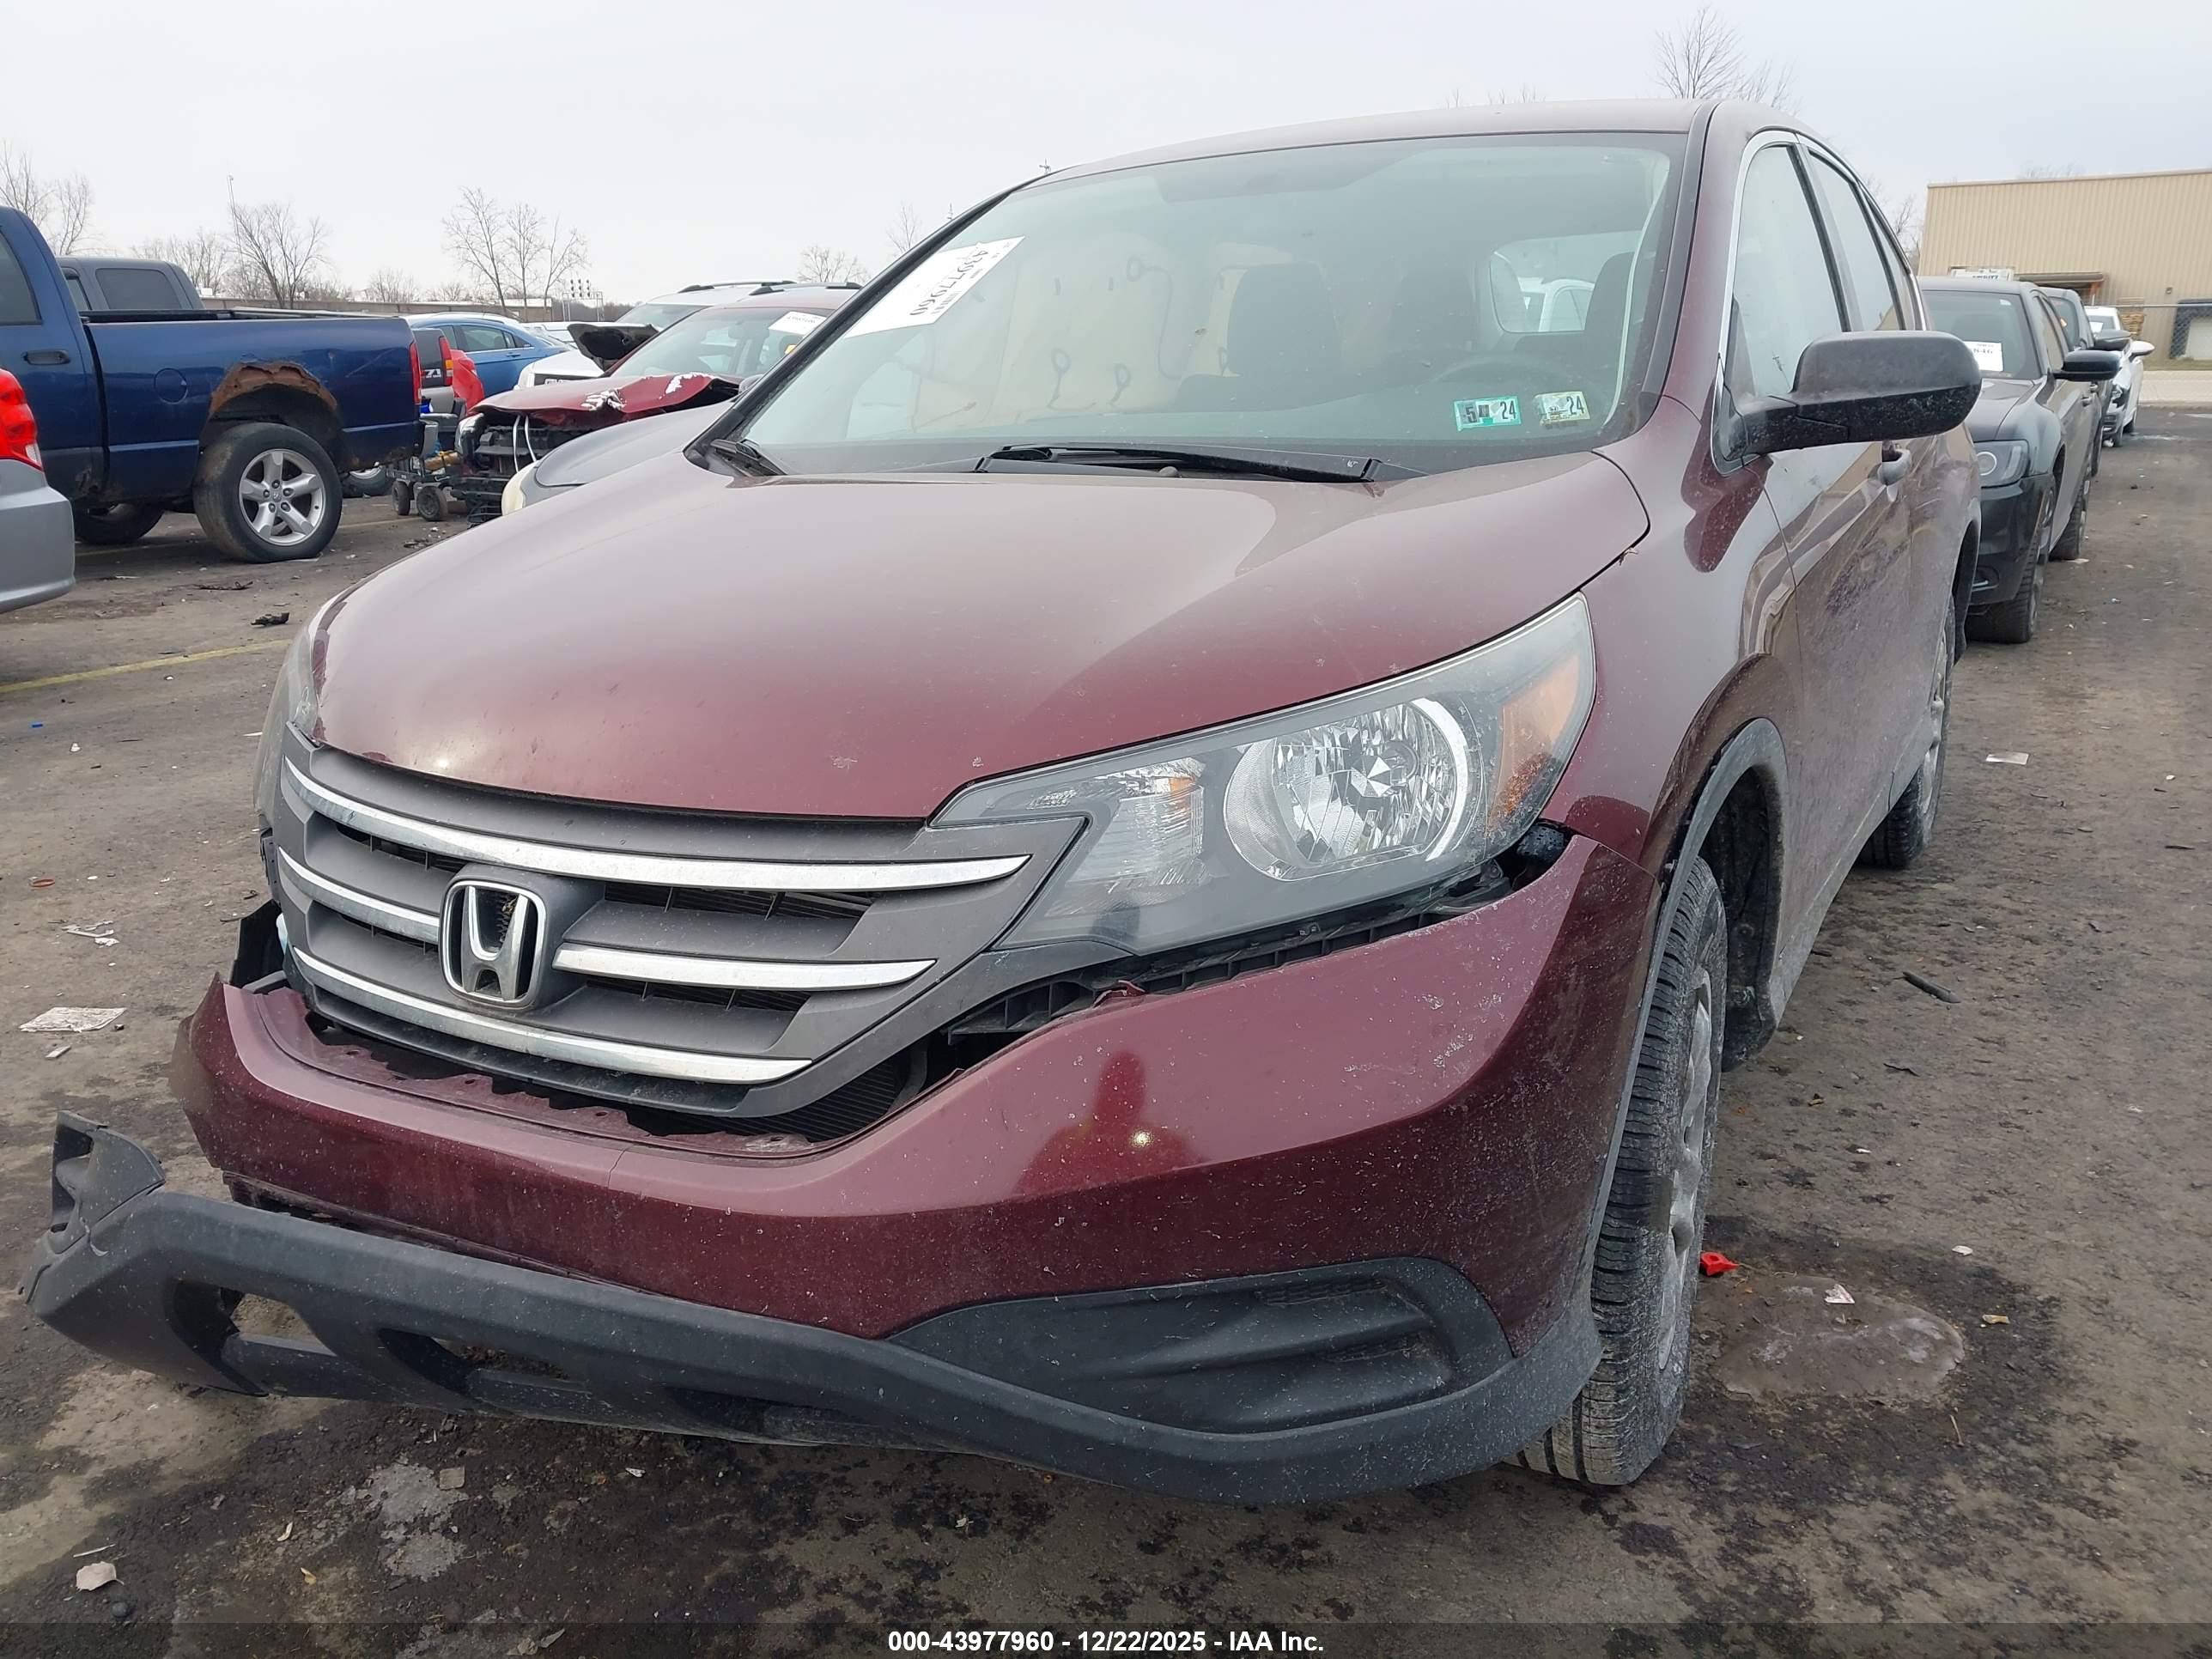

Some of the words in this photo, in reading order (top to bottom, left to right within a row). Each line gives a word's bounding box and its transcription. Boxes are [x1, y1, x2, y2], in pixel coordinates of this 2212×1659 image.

[908, 249, 988, 316] 43977960
[1465, 406, 1478, 423] 5
[1500, 400, 1516, 420] 24
[1566, 395, 1584, 416] 24
